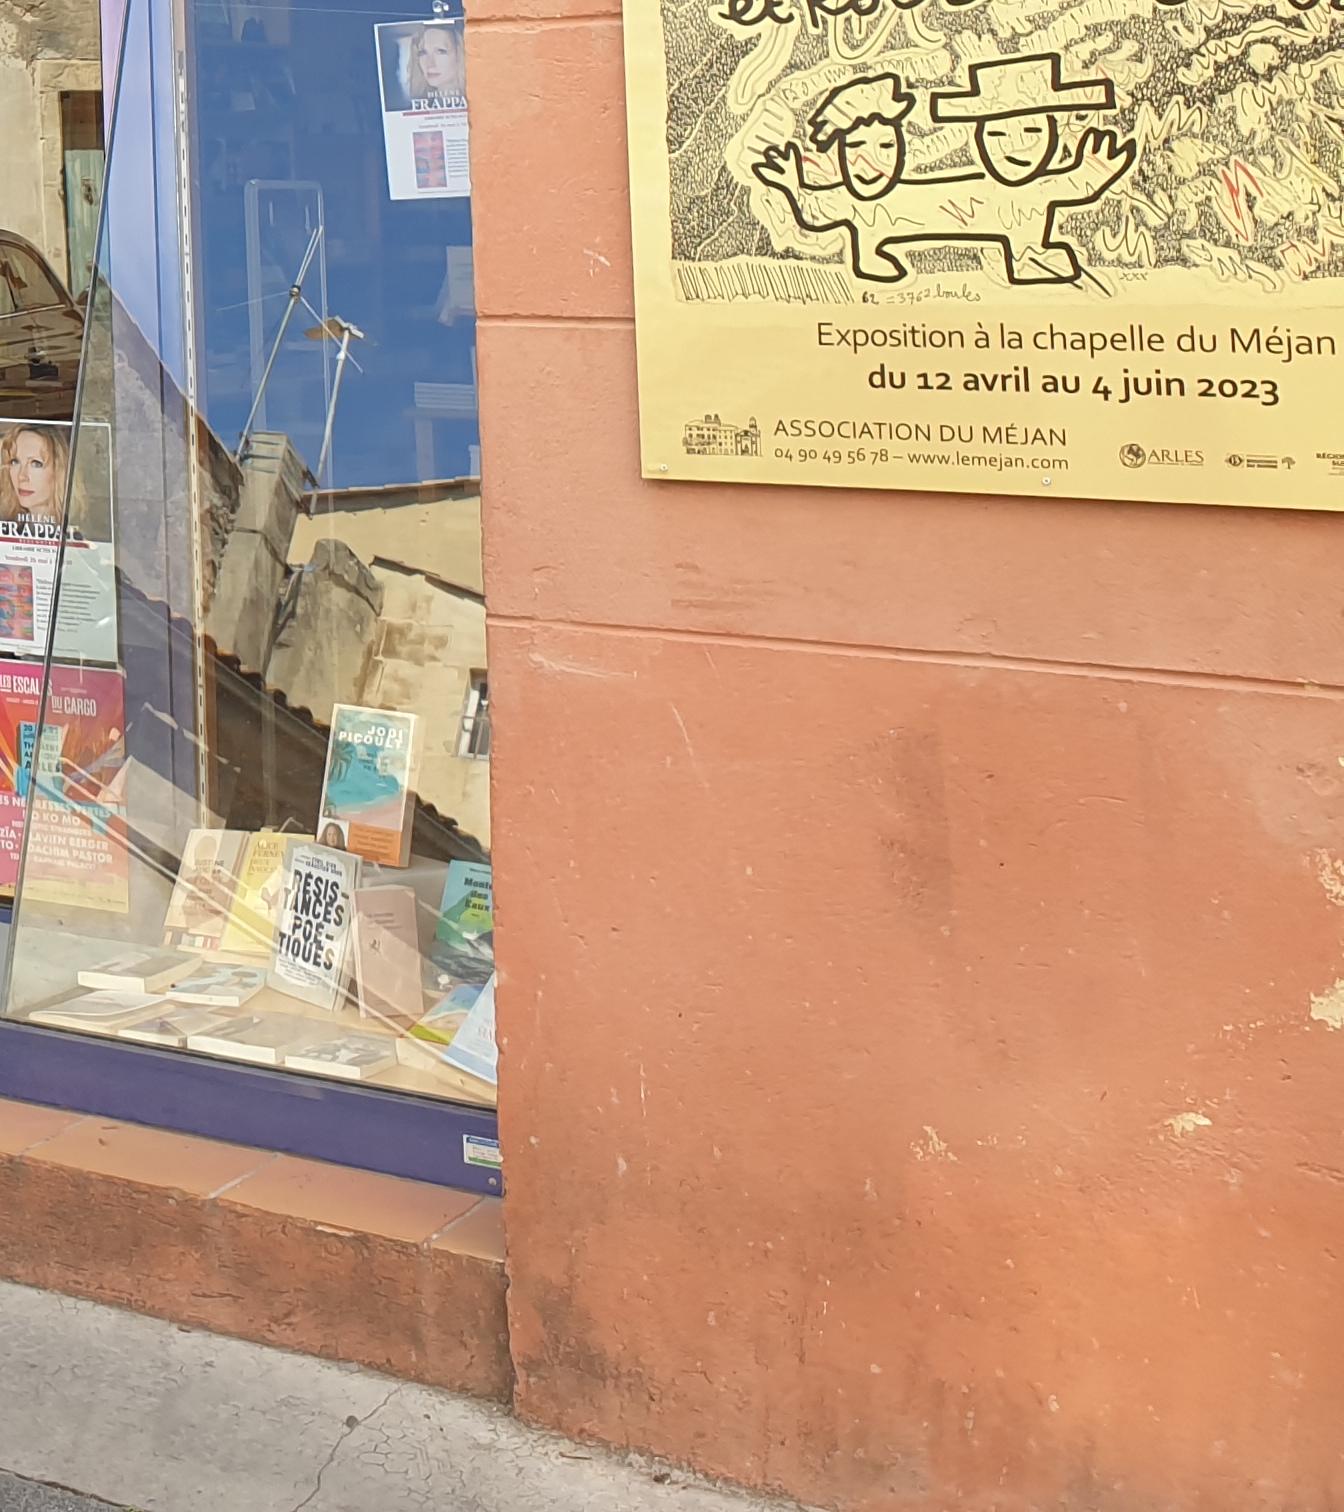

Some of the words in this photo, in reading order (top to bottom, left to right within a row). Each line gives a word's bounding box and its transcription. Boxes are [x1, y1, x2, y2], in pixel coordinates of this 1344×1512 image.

[817, 321, 965, 354] Exposition
[973, 322, 991, 350] à
[999, 322, 1024, 350] la
[1032, 323, 1165, 359] chapelle
[1176, 325, 1218, 354] du
[1230, 327, 1336, 363] Méjan
[867, 363, 907, 390] du
[916, 371, 952, 390] 12
[962, 365, 1030, 393] avril
[1041, 371, 1080, 394] au
[1091, 375, 1113, 402] 4
[1118, 368, 1186, 404] juin
[1195, 378, 1280, 407] 2023
[773, 418, 932, 442] ASSOCIATION
[939, 424, 974, 443] DU
[982, 422, 1068, 447] MÉJAN
[773, 448, 794, 463] 04
[798, 447, 818, 463] 90
[822, 449, 843, 465] 49
[847, 447, 867, 465] 56
[869, 447, 890, 466] 78
[907, 451, 1070, 472] www.lemejan.com
[1148, 448, 1205, 464] ARLES
[0, 674, 12, 689] LES
[12, 675, 53, 697] ESCALS
[64, 695, 97, 718] CARGO
[338, 730, 404, 750] PICOULT
[366, 725, 404, 739] JODI
[22, 841, 70, 858] OACHIM
[72, 848, 113, 864] PASTOR
[23, 834, 64, 847] LAVIEN
[69, 837, 109, 851] BERGER
[283, 887, 345, 928] TANCES
[278, 931, 336, 971] TIQUES
